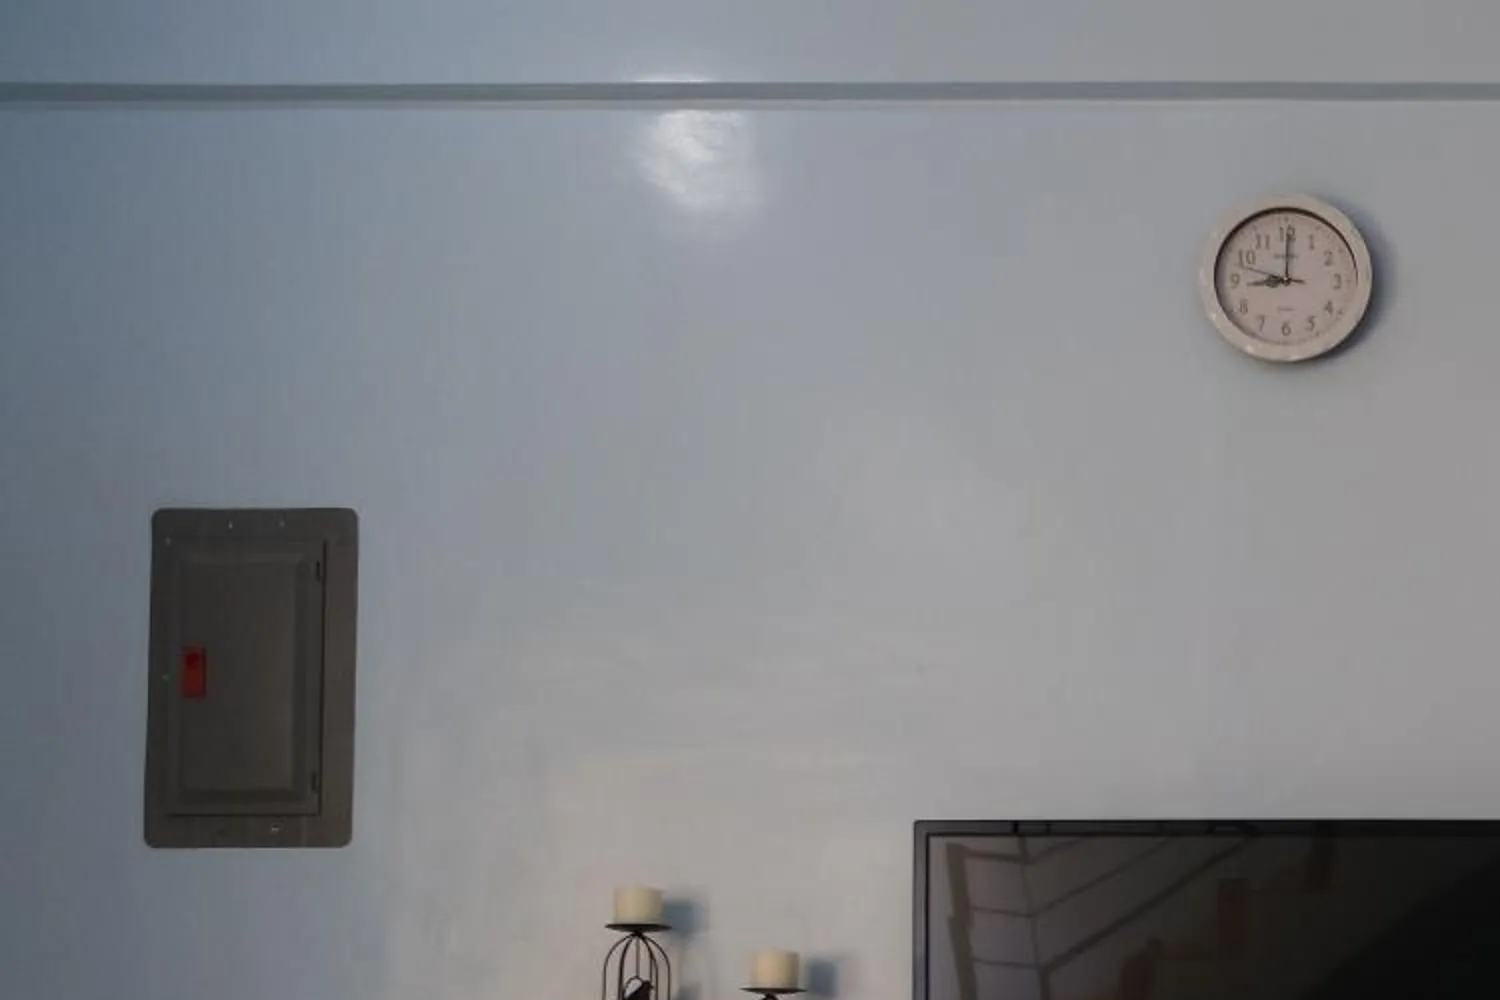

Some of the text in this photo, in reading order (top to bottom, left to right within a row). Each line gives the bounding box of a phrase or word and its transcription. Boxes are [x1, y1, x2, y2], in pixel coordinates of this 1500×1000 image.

[1279, 224, 1296, 242] 12
[1255, 233, 1270, 250] 11
[1308, 233, 1315, 250] 1
[1238, 249, 1256, 265] 10
[1323, 250, 1333, 266] 2
[1230, 273, 1240, 288] 9
[1333, 274, 1342, 289] 3
[1238, 299, 1248, 314] 8
[1323, 300, 1333, 315] 4
[1257, 315, 1265, 332] 7
[1281, 322, 1291, 336] 6
[1307, 315, 1316, 331] 5
